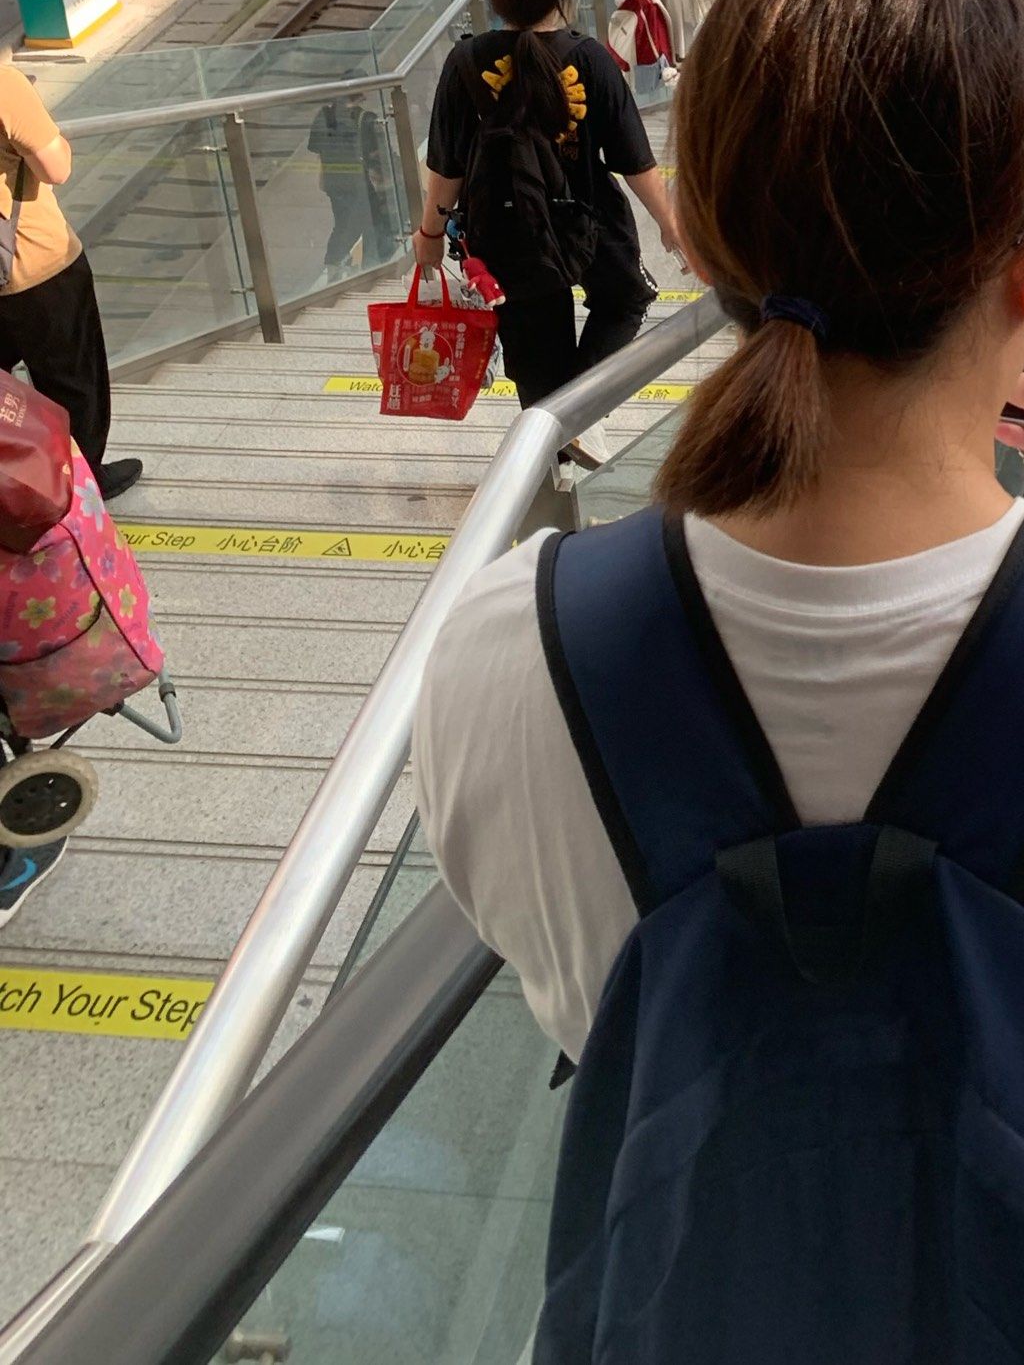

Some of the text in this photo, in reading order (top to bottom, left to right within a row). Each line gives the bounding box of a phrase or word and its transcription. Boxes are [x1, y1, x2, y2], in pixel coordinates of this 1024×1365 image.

[350, 381, 383, 392] Watc
[151, 531, 195, 549] Step
[216, 534, 303, 554] 小心台阶
[383, 540, 445, 559] 小心台
[52, 984, 129, 1019] Your
[131, 989, 207, 1032] Step
